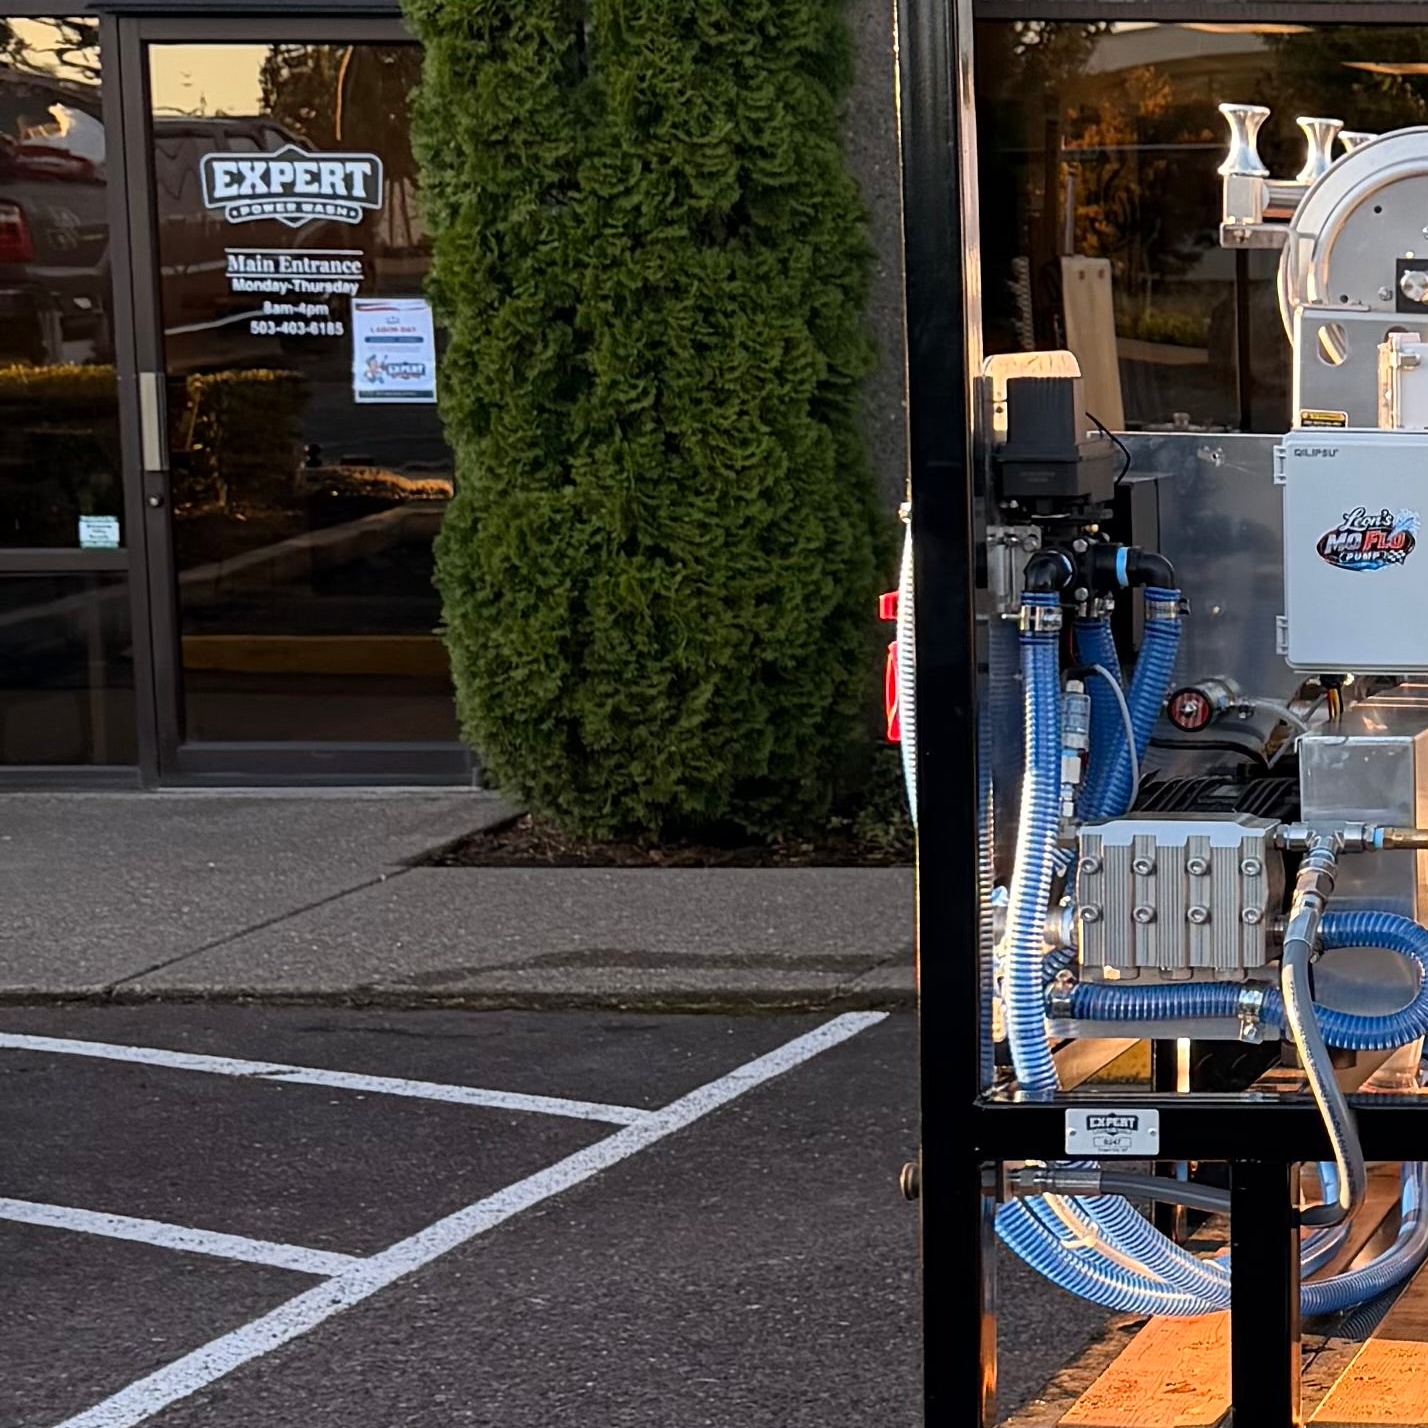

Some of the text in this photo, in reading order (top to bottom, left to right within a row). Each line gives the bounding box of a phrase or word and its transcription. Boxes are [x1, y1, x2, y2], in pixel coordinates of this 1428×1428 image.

[212, 161, 371, 198] EXPERT
[240, 203, 347, 216] POWER WASH
[227, 254, 362, 274] Main Entrance
[232, 278, 359, 296] Monday-Thursday
[263, 300, 329, 317] 8am-4pm
[1338, 506, 1394, 532] Leon's
[1324, 530, 1406, 554] MO FLO
[1346, 551, 1382, 562] PUMP
[1089, 1117, 1136, 1128] EXPERT
